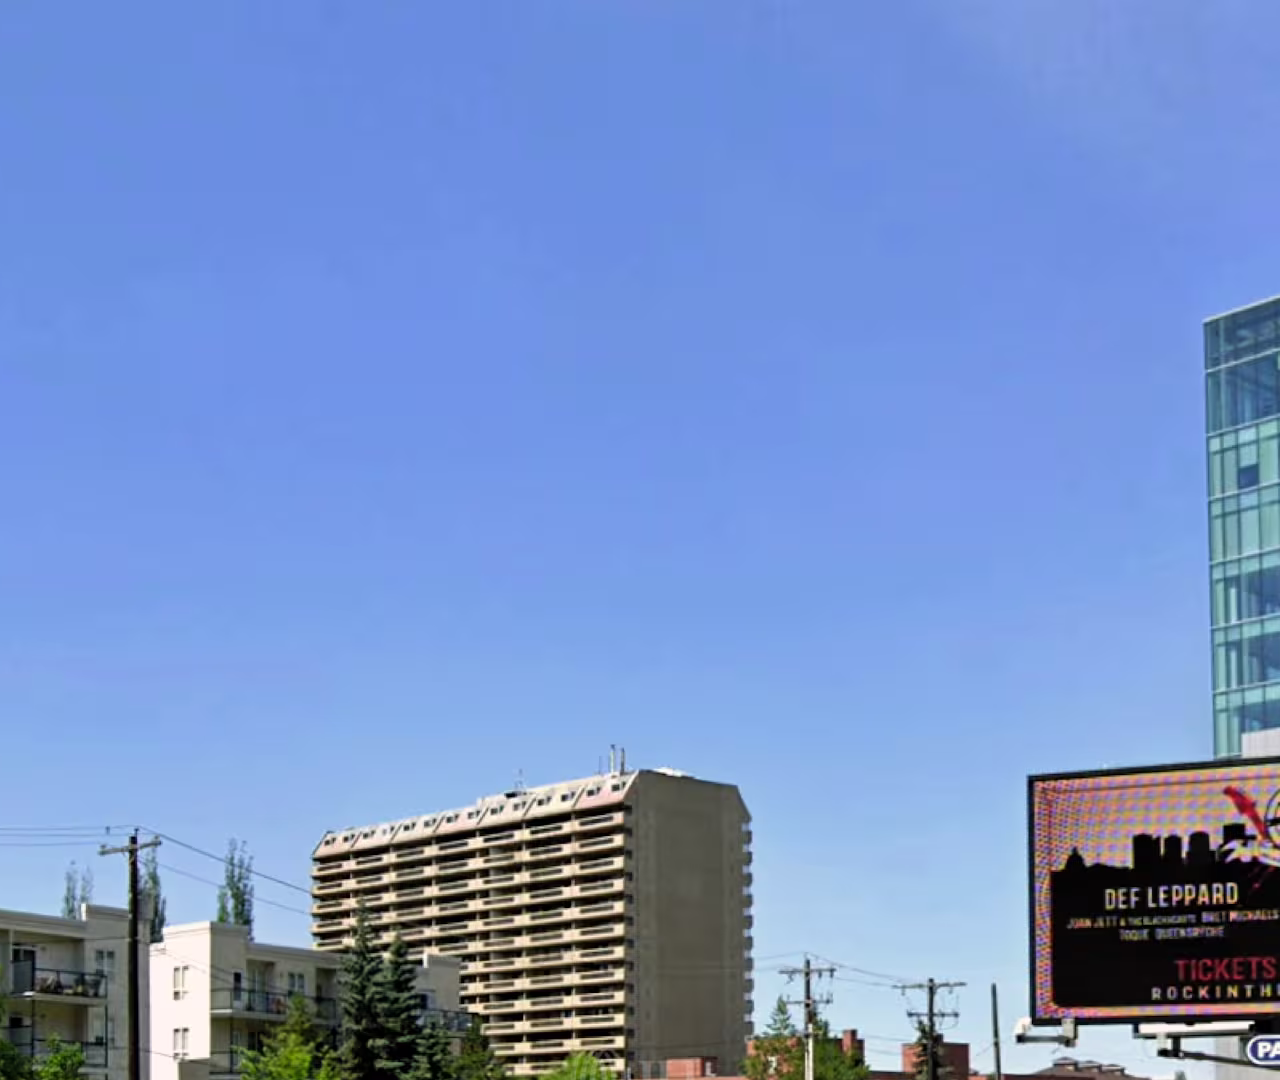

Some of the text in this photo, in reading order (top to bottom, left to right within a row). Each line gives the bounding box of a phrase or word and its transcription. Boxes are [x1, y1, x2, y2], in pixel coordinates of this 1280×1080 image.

[1104, 881, 1239, 911] DEF LEPPARD
[1174, 955, 1277, 982] TICKETS
